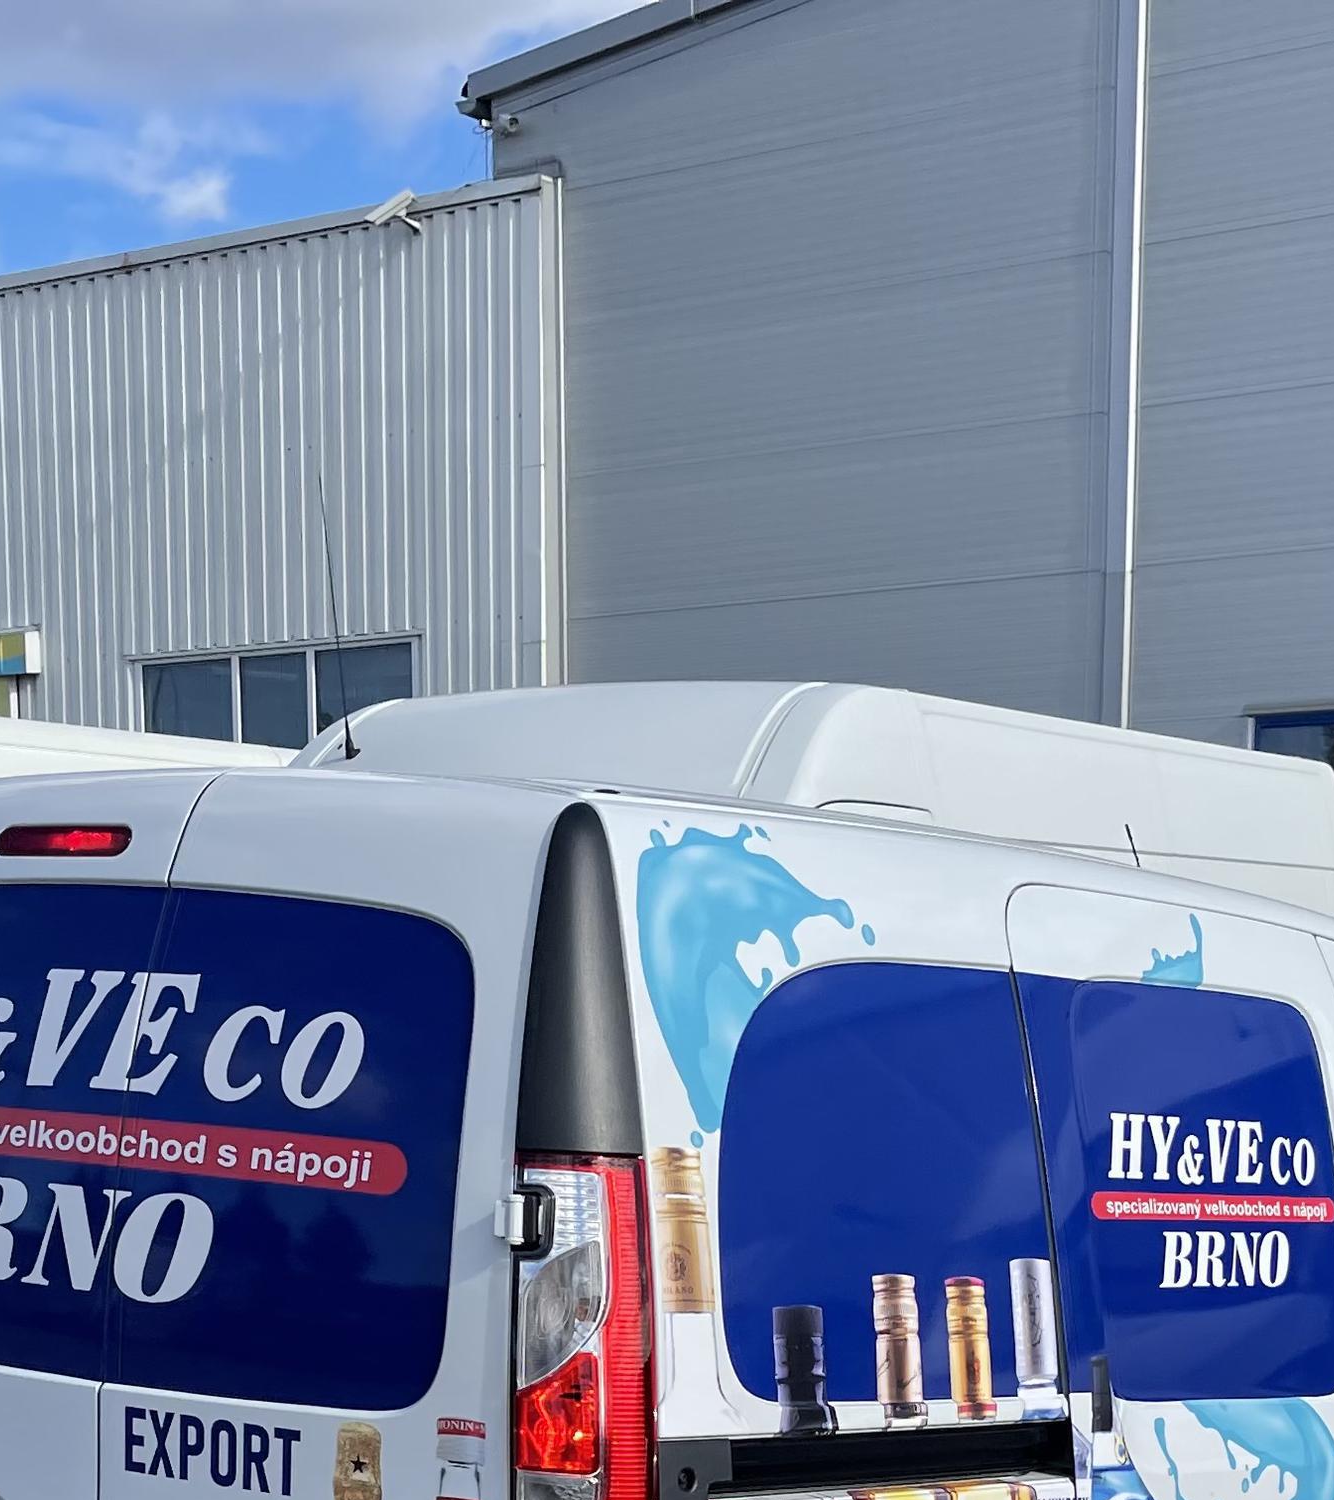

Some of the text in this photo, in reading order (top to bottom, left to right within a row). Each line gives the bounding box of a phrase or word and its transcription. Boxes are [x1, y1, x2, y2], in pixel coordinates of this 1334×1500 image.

[217, 1143, 236, 1168] s
[251, 1141, 373, 1190] nápoji
[1106, 1198, 1328, 1221] specializovaný velkoobchod s nápoji
[1159, 1230, 1290, 1289] BRNO
[124, 1406, 301, 1496] EXPORT
